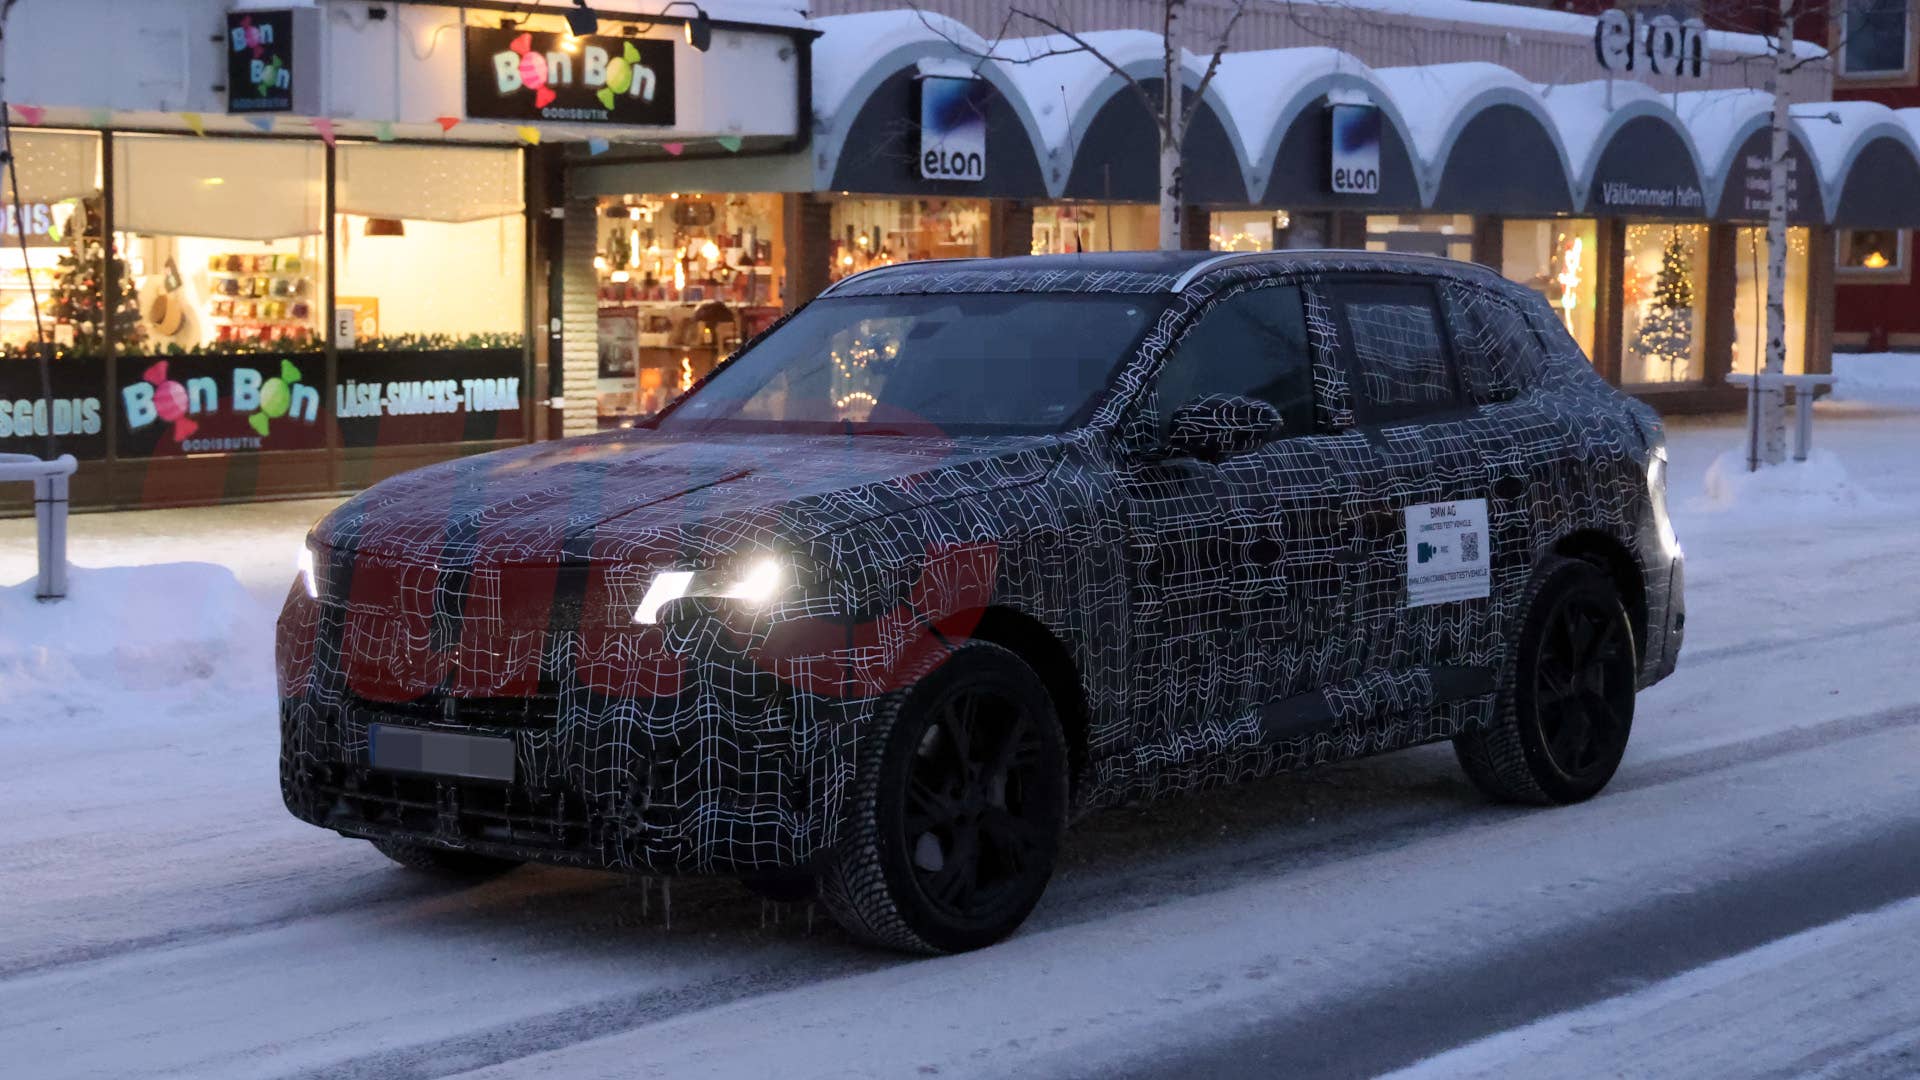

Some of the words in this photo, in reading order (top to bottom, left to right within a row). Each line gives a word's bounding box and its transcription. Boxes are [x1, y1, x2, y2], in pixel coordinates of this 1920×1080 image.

[232, 21, 273, 54] Bon
[1595, 9, 1711, 78] elon
[250, 57, 290, 91] Bon
[494, 44, 572, 98] Bon
[584, 45, 656, 104] Bon
[924, 150, 981, 176] elon
[1335, 168, 1377, 189] elon
[1602, 182, 1674, 206] Välkommen
[122, 371, 218, 434] Bon
[233, 364, 319, 427] Bon
[182, 437, 262, 451] GODISBUTIK
[1430, 506, 1446, 518] BMW
[1447, 504, 1456, 516] AG
